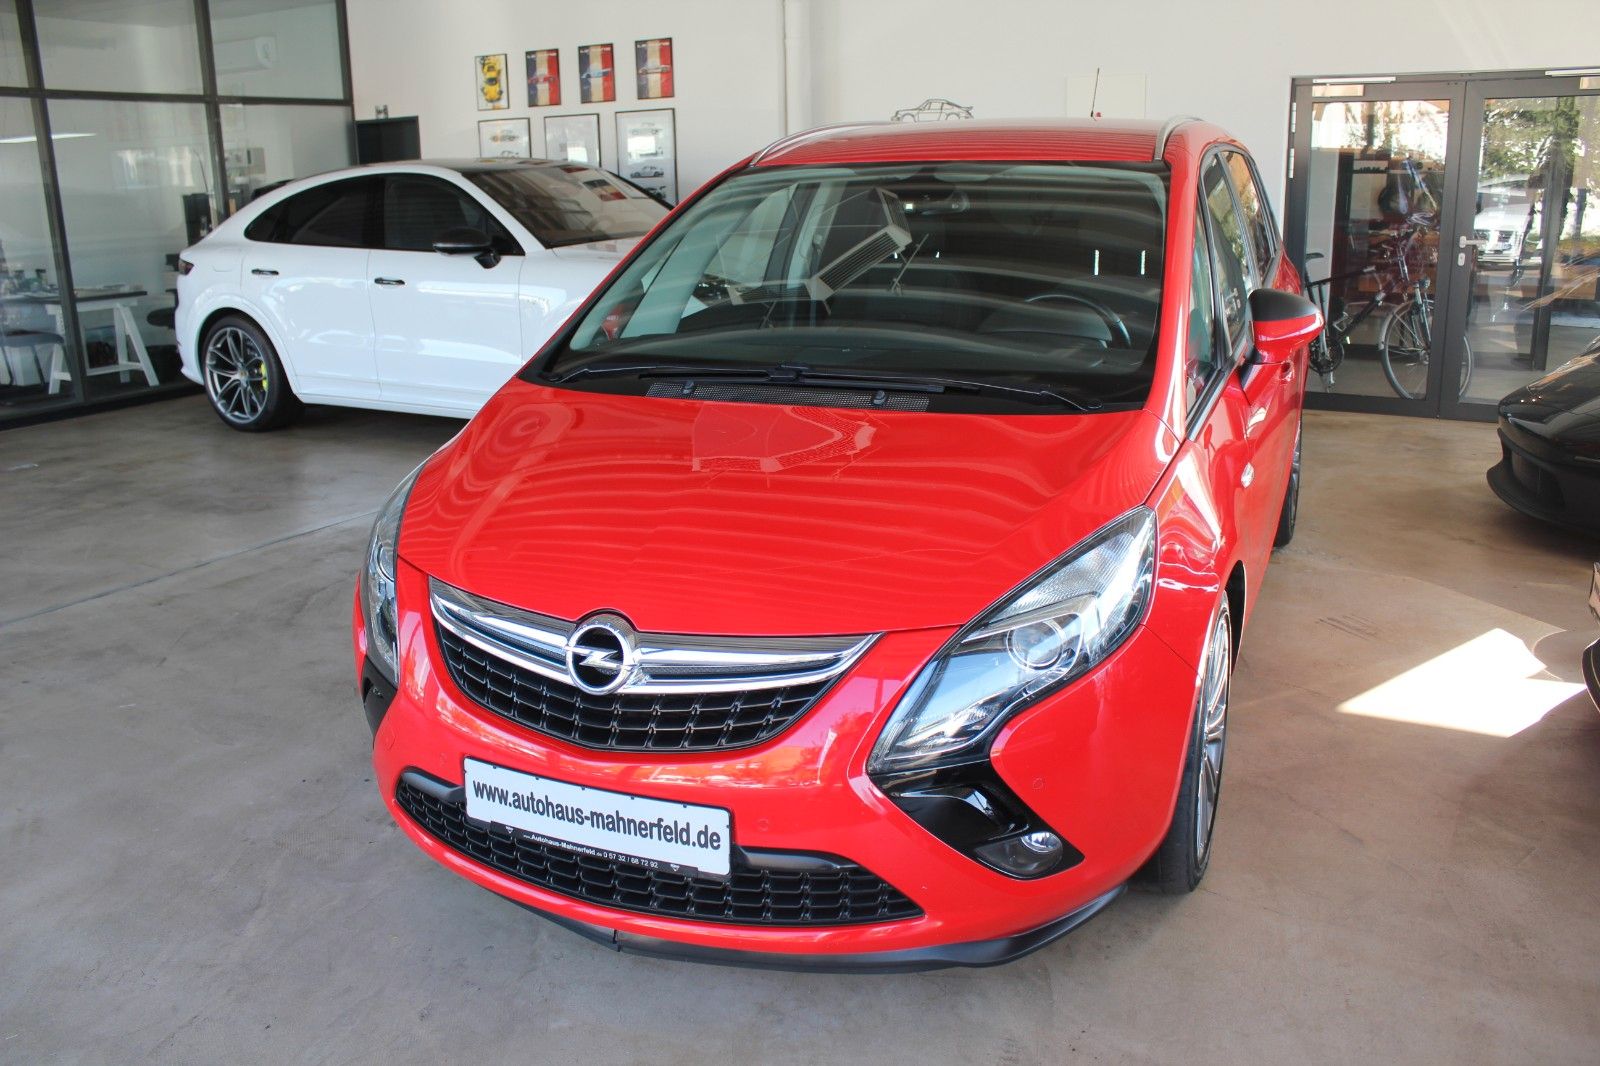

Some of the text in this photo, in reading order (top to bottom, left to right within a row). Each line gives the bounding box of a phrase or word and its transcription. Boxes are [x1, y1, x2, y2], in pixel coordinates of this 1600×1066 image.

[473, 780, 721, 850] www.autohaus-mahnerfeld.de
[618, 854, 627, 862] 32
[640, 859, 649, 867] 72
